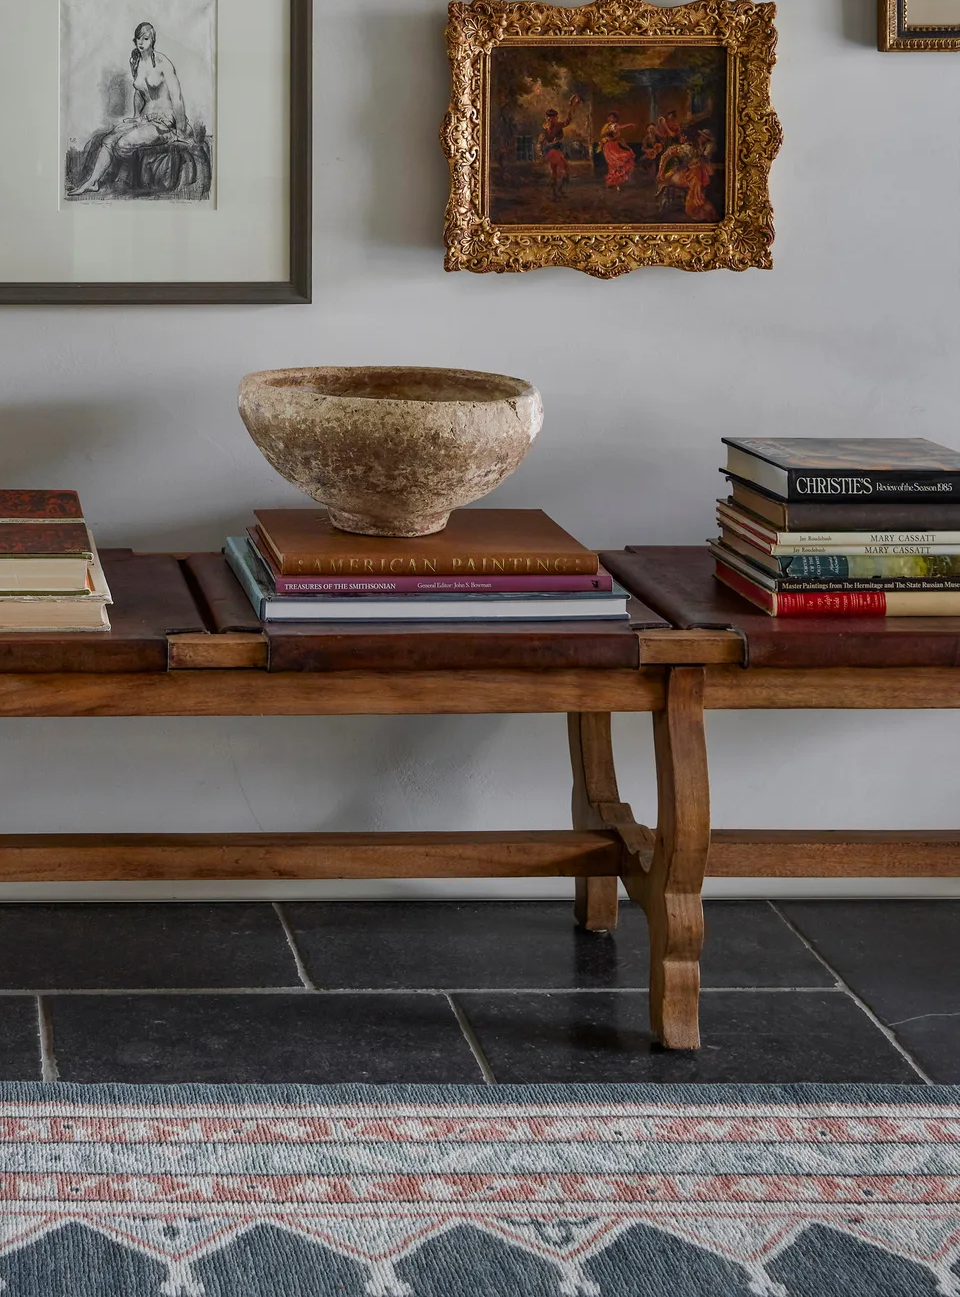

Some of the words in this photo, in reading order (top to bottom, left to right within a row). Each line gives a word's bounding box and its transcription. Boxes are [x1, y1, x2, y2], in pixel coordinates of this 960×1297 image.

[796, 477, 873, 494] CHRISTIE'S
[876, 482, 898, 492] Review
[913, 482, 937, 492] Season
[937, 482, 953, 492] 1985
[870, 534, 895, 543] MARY
[898, 534, 936, 543] CASSATT
[864, 546, 889, 554] MARY
[892, 546, 931, 554] CASSATT
[313, 557, 437, 573] AMERICAN
[451, 557, 568, 572] PAINTING
[284, 583, 322, 591] TREASURES
[453, 582, 465, 590] John
[782, 582, 802, 590] Master
[802, 582, 828, 591] Paintings
[854, 582, 883, 590] Hermitage
[884, 581, 894, 589] and
[895, 581, 905, 589] The
[906, 581, 921, 589] State
